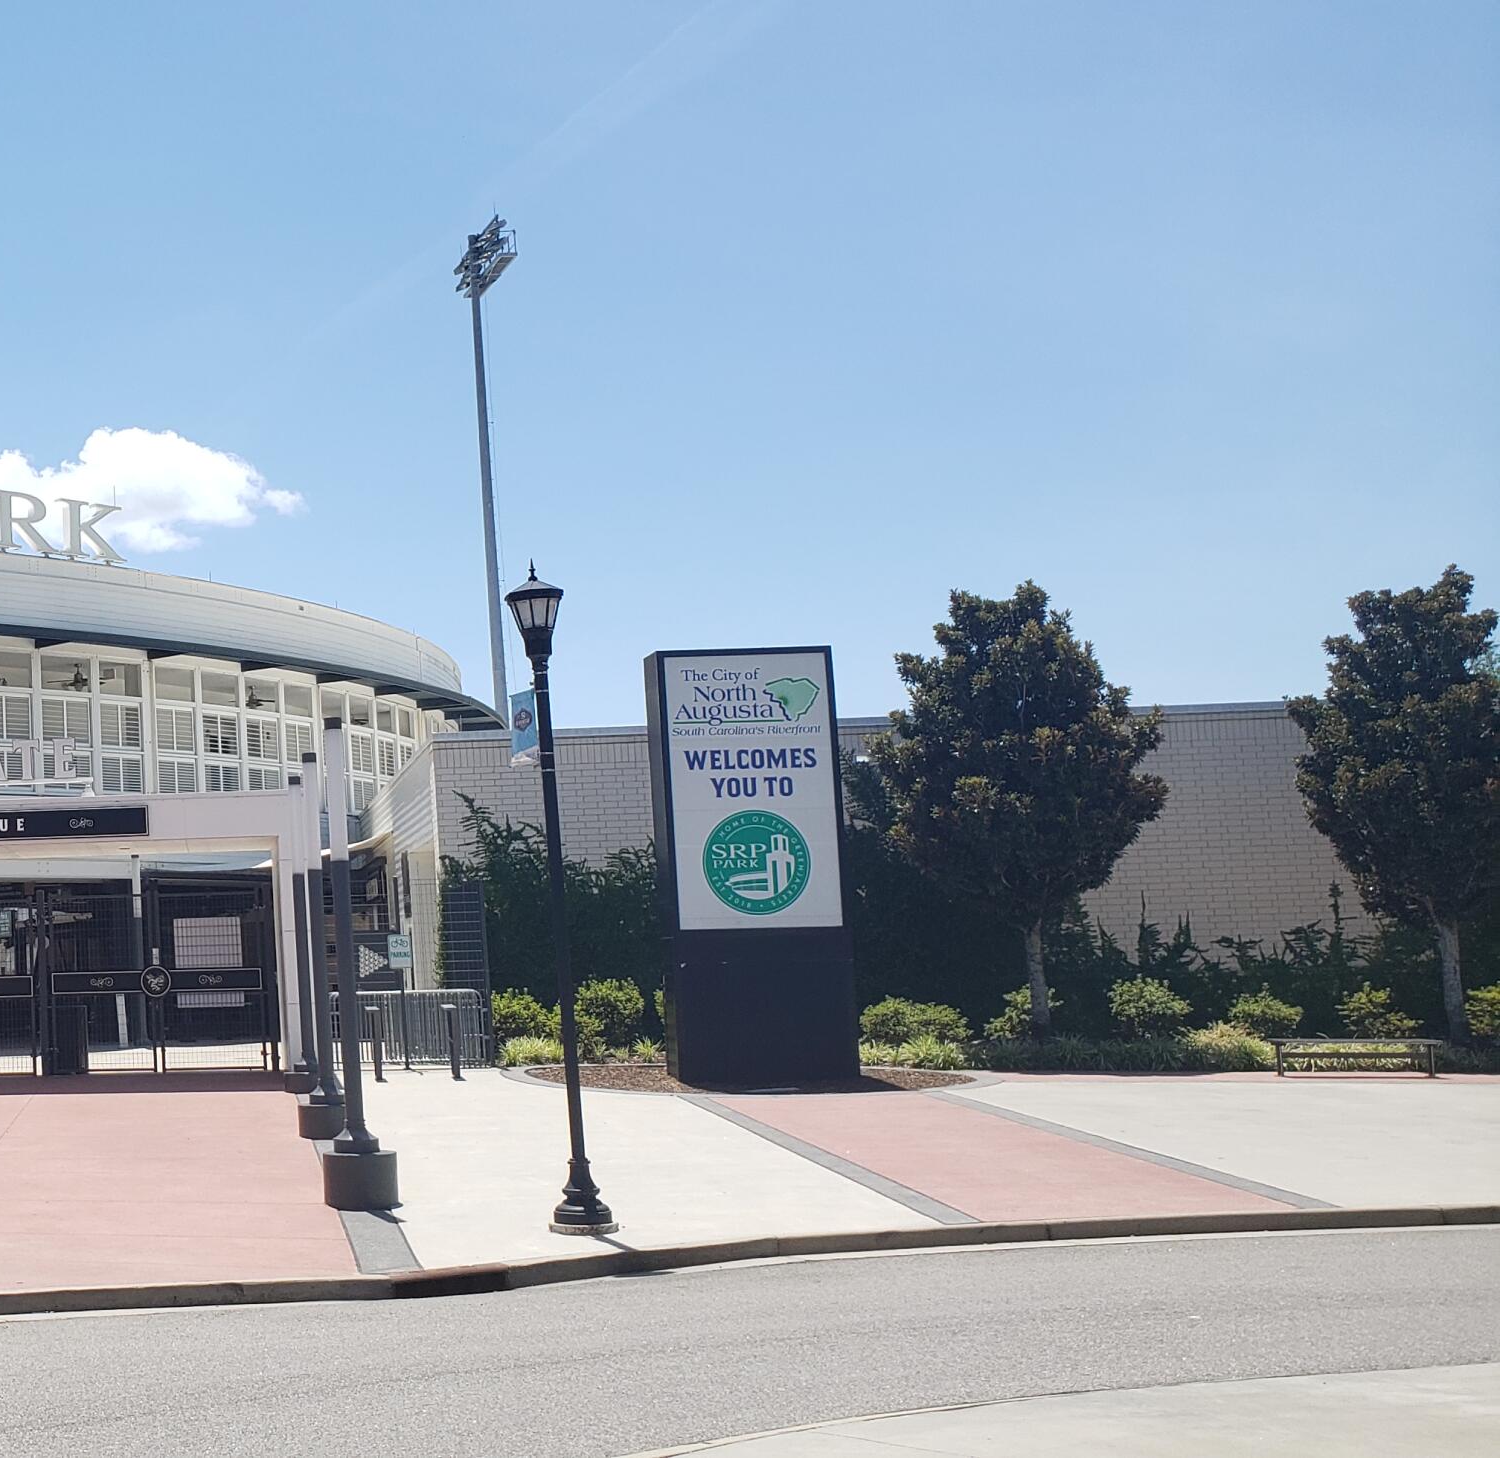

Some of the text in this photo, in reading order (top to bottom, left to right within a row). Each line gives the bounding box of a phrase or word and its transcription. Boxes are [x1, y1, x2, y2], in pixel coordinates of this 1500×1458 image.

[681, 668, 760, 684] The City of
[694, 684, 756, 702] North
[675, 704, 774, 726] Augusta
[672, 725, 820, 736] South Carolina's Riverfront
[684, 748, 817, 770] WELCOMES
[710, 777, 793, 797] YOU TO
[719, 817, 745, 838] HOME
[772, 820, 789, 834] THE
[711, 843, 767, 859] SRP
[713, 859, 759, 868] PARK
